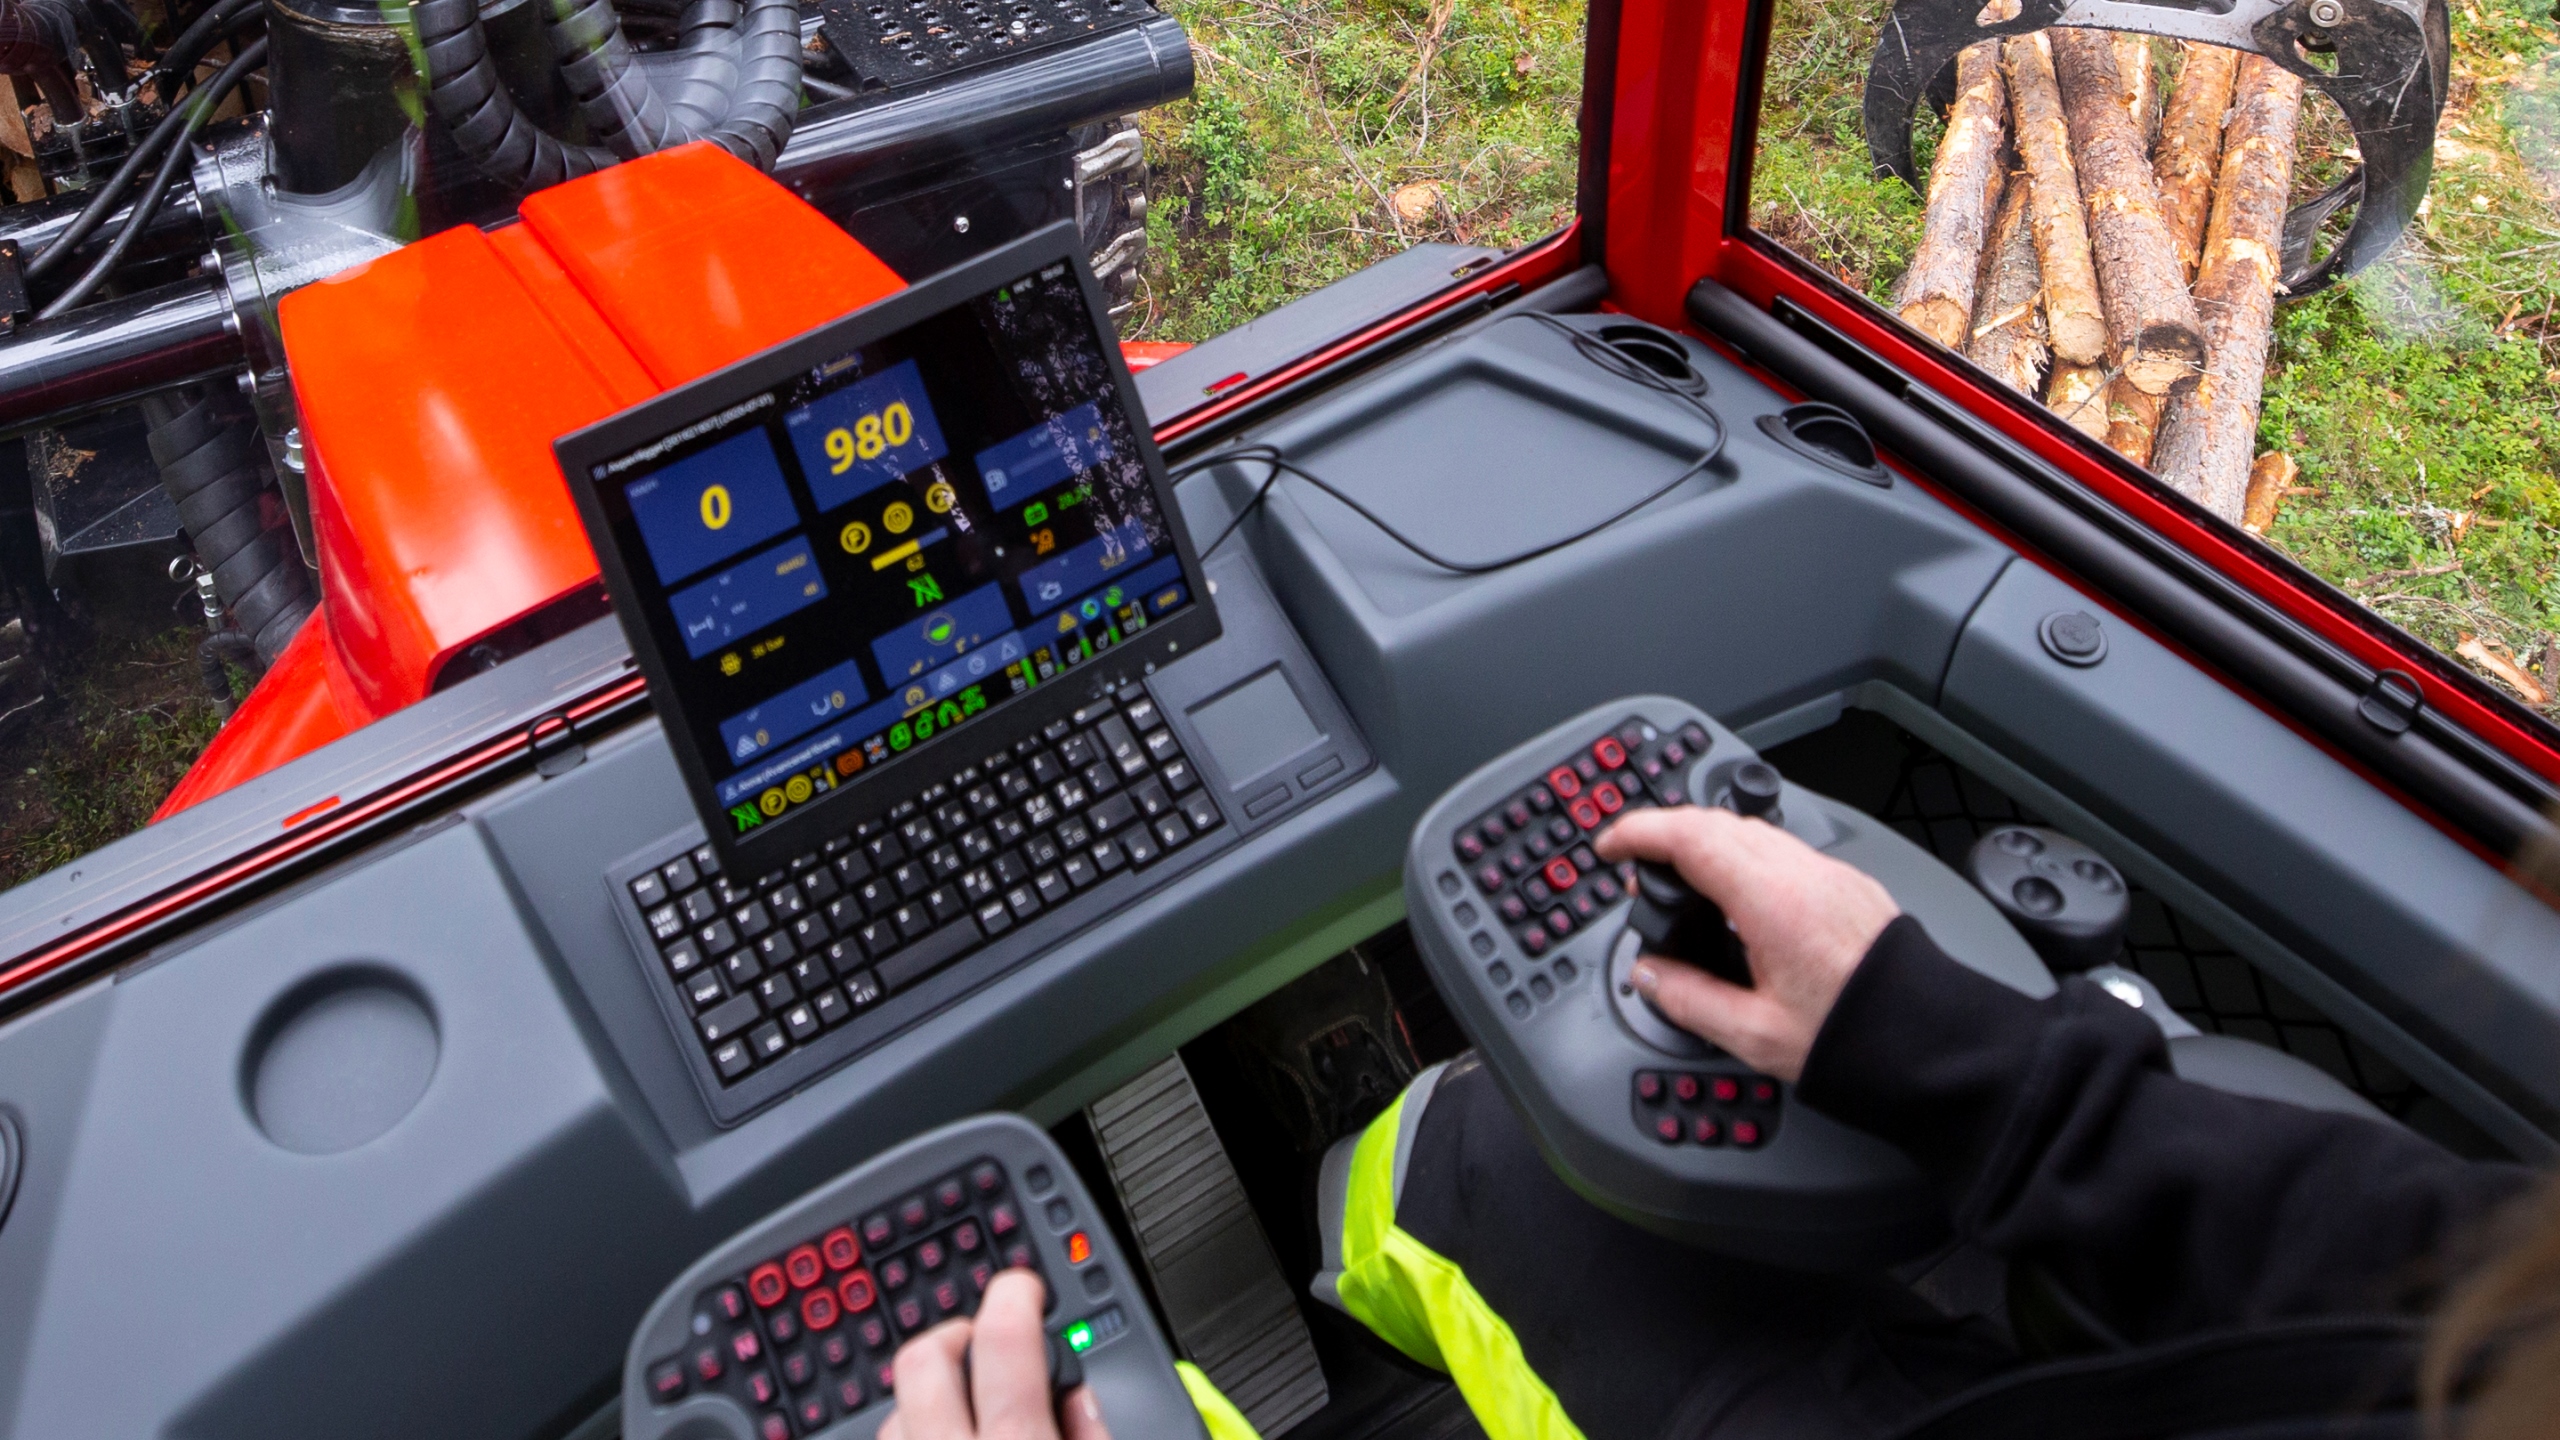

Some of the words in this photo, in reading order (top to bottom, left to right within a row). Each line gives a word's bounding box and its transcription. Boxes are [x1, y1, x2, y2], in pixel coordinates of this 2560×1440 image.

[824, 401, 913, 475] 980
[700, 484, 731, 530] 0
[970, 789, 981, 803] O
[905, 823, 916, 837] U
[962, 832, 974, 847] K
[864, 925, 875, 940] V
